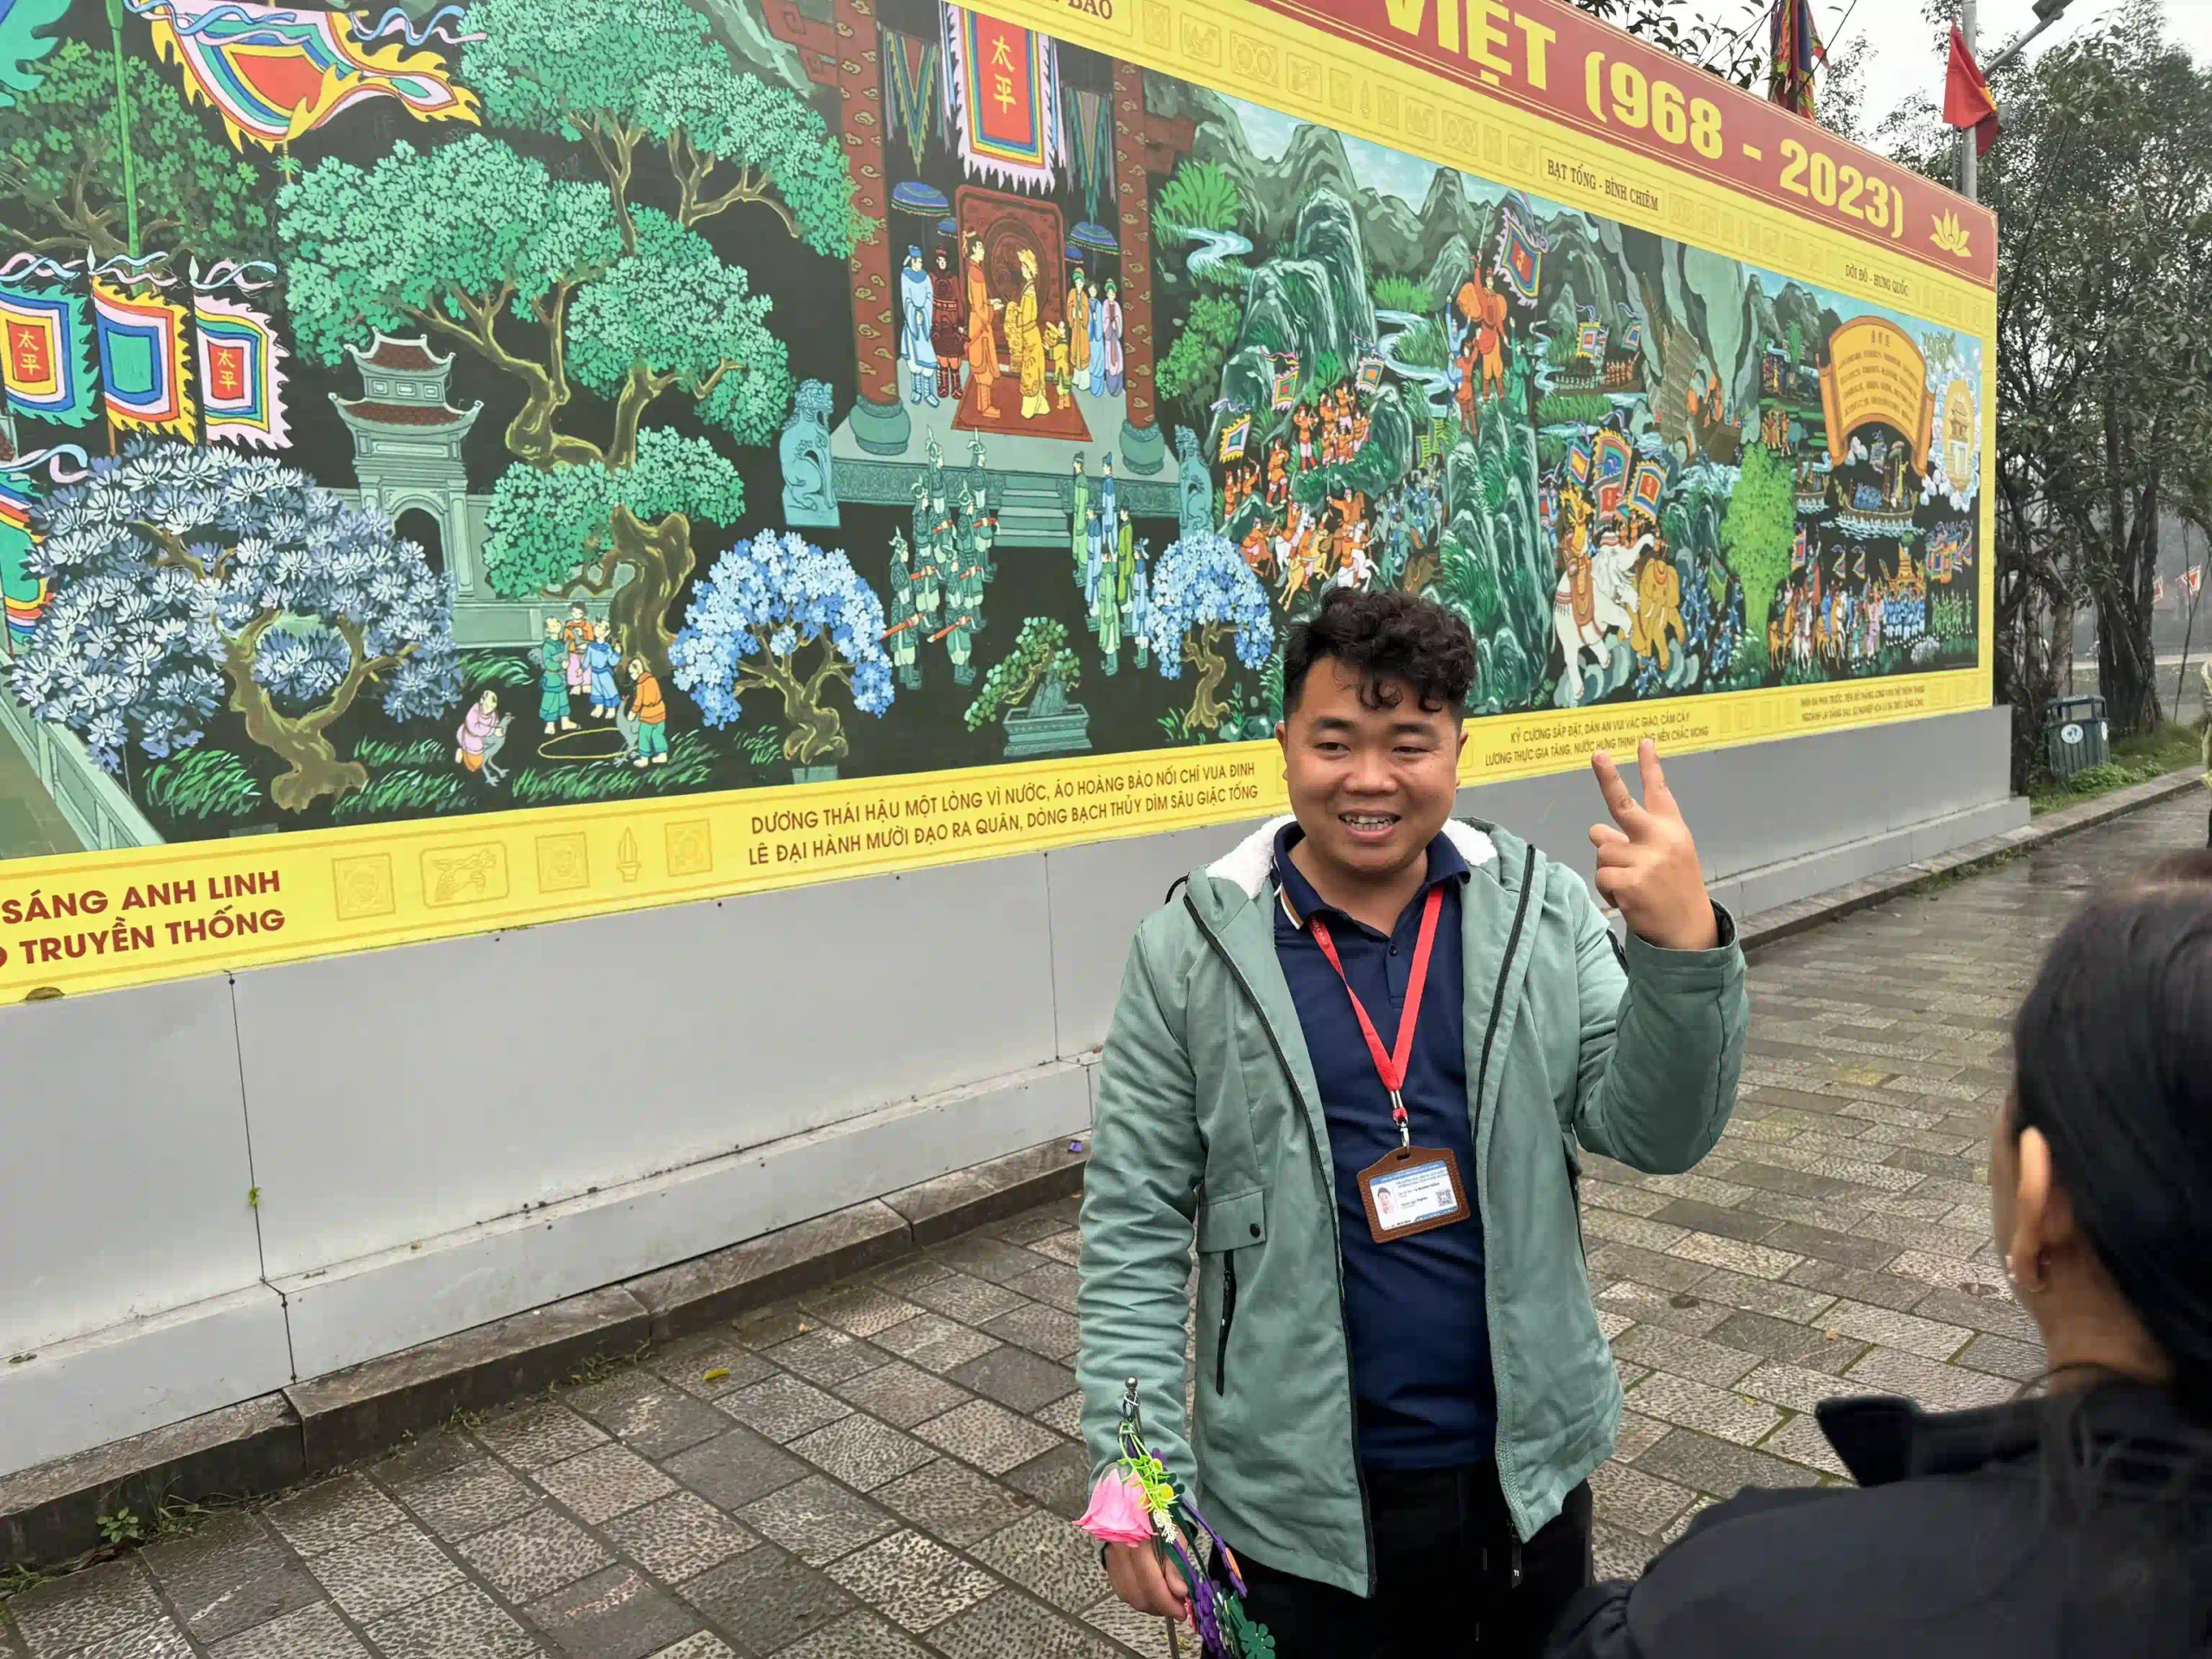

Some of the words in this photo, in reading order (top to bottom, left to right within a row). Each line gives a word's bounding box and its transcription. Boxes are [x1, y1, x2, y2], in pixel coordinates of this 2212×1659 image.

[991, 35, 1017, 114] 太平
[1585, 51, 1723, 160] (968
[1743, 143, 1762, 161] -
[1780, 138, 1904, 238] 2023)
[1548, 159, 1567, 181] BẠT
[1571, 163, 1596, 190] TỐNG
[1605, 177, 1628, 201] BÌNH
[1630, 188, 1658, 211] CHIÊM
[17, 330, 41, 375] 太平
[217, 348, 238, 391] 太平
[1485, 751, 1512, 766] LƯƠNG
[1514, 747, 1534, 762] THỰC
[1535, 747, 1548, 760] GIA
[1523, 727, 1551, 741] CƯƠNG
[1601, 721, 1611, 733] AN
[1612, 719, 1624, 730] VUI
[749, 842, 769, 865] LÊ
[777, 842, 807, 864] ĐẠI
[813, 834, 861, 857] HÀNH
[867, 824, 908, 850] MƯỜI
[915, 825, 948, 845] ĐẠO
[952, 821, 975, 838] RA
[976, 811, 1023, 835] QUÂN,
[1027, 807, 1068, 829] DÒNG
[1071, 804, 1107, 823] BẠCH
[1110, 794, 1141, 817] THỦY
[1146, 792, 1167, 811] DÌM
[1171, 791, 1193, 809] SÂU
[1197, 786, 1226, 806] GIẶC
[1229, 779, 1258, 801] TỐNG
[752, 810, 818, 835] DƯƠNG
[823, 803, 860, 826] THÁI
[866, 798, 899, 823] HẬU
[906, 794, 937, 817] MỘT
[942, 792, 982, 812] LÒNG
[987, 786, 1001, 806] VÌ
[1005, 784, 1050, 806] NƯỚC,
[1054, 777, 1074, 799] ÁO
[1077, 774, 1124, 796] HOÀNG
[1156, 765, 1177, 785] NỐI
[1179, 765, 1200, 784] CHÍ
[1203, 765, 1226, 780] VUA
[1230, 762, 1255, 778] ĐINH
[2, 889, 109, 925] SÁNG
[122, 880, 196, 911] ANH
[208, 870, 281, 899] LINH
[19, 916, 155, 964] TRUYỀN
[165, 905, 285, 944] THỐNG
